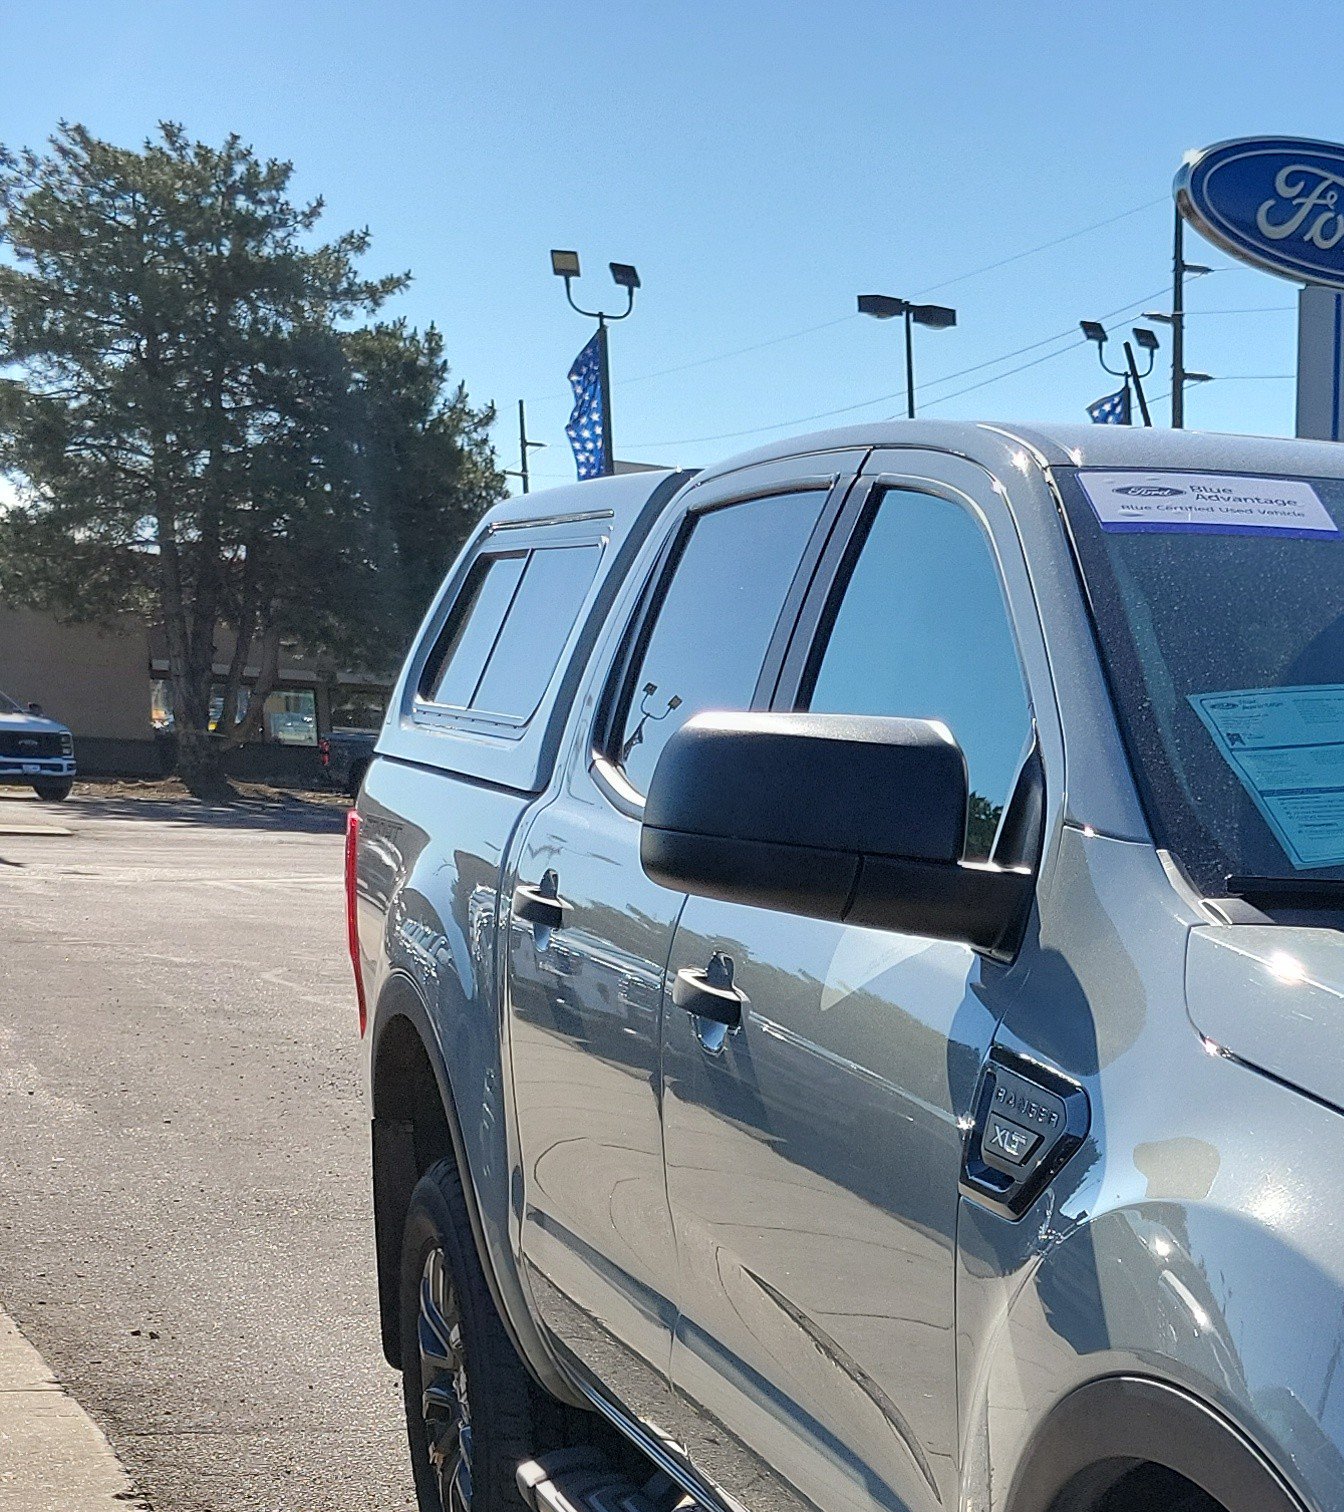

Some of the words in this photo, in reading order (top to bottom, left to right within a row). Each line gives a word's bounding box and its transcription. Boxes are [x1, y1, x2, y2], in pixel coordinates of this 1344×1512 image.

[1189, 485, 1233, 494] Blue
[1195, 493, 1298, 507] Advantage
[1156, 504, 1215, 513] Certified
[995, 1088, 1060, 1128] RANGER
